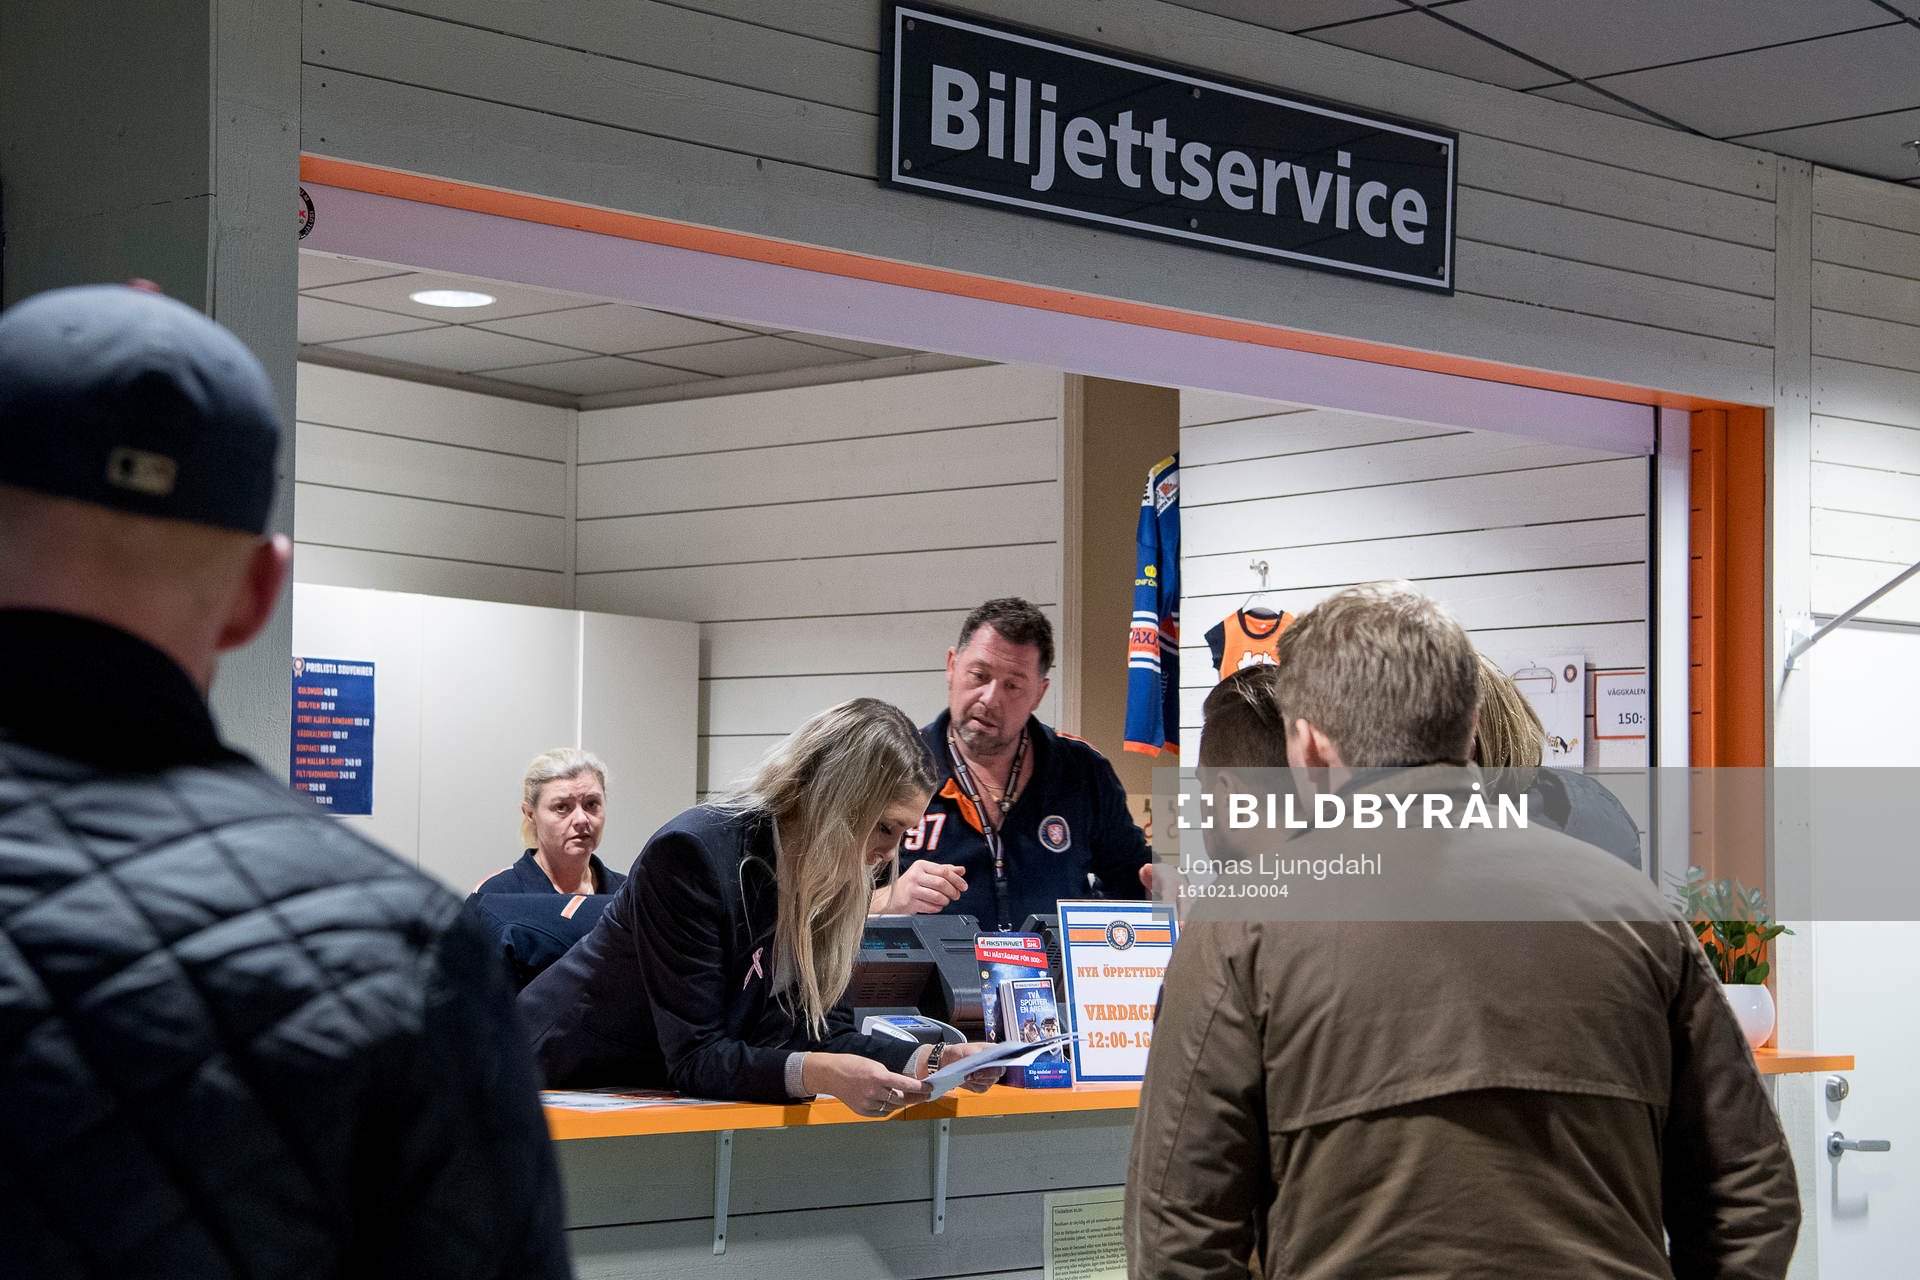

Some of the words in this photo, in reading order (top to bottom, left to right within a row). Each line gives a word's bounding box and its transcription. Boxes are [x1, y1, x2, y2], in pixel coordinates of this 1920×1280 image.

[930, 63, 1428, 244] Biljettservice
[305, 662, 337, 674] PRISLISTA
[1077, 966, 1099, 978] NYA
